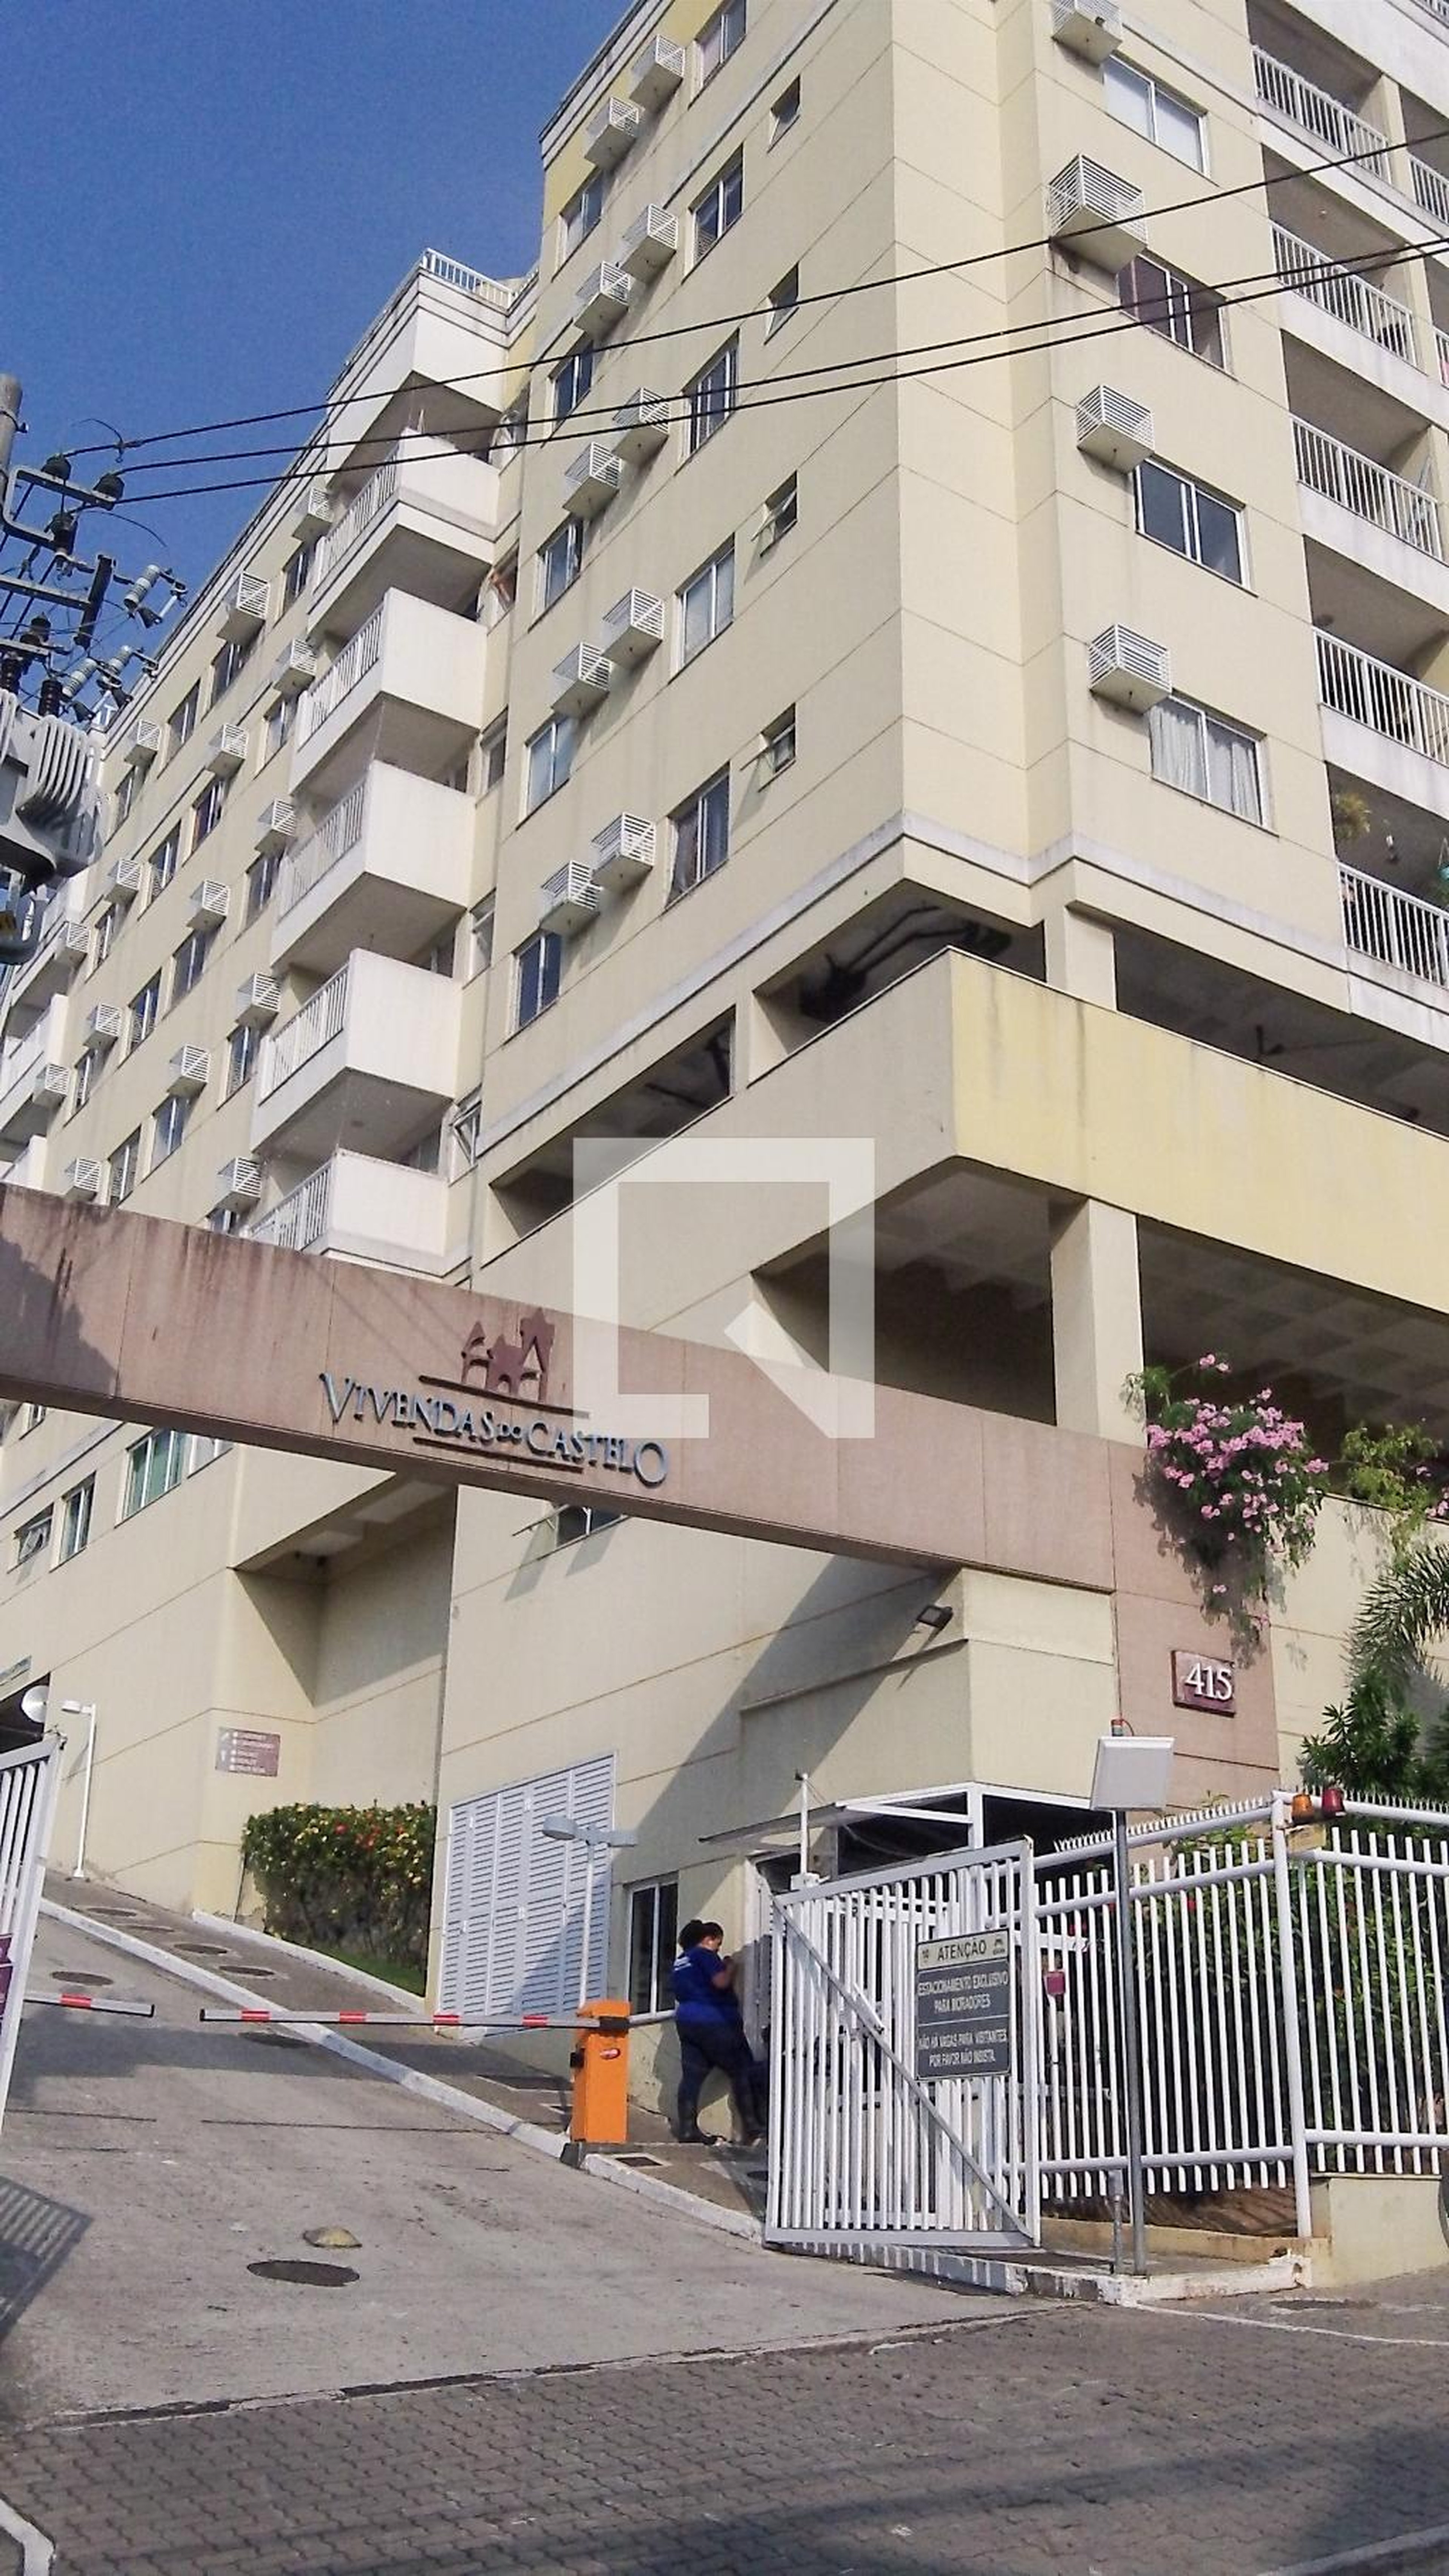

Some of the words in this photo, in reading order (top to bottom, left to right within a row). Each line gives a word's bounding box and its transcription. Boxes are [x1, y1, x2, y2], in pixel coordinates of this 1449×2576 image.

[320, 1372, 494, 1446] VIVENDAS
[528, 1420, 668, 1488] CASTELO
[1184, 1663, 1232, 1701] 415
[937, 1937, 986, 1961] ATENÇÃO
